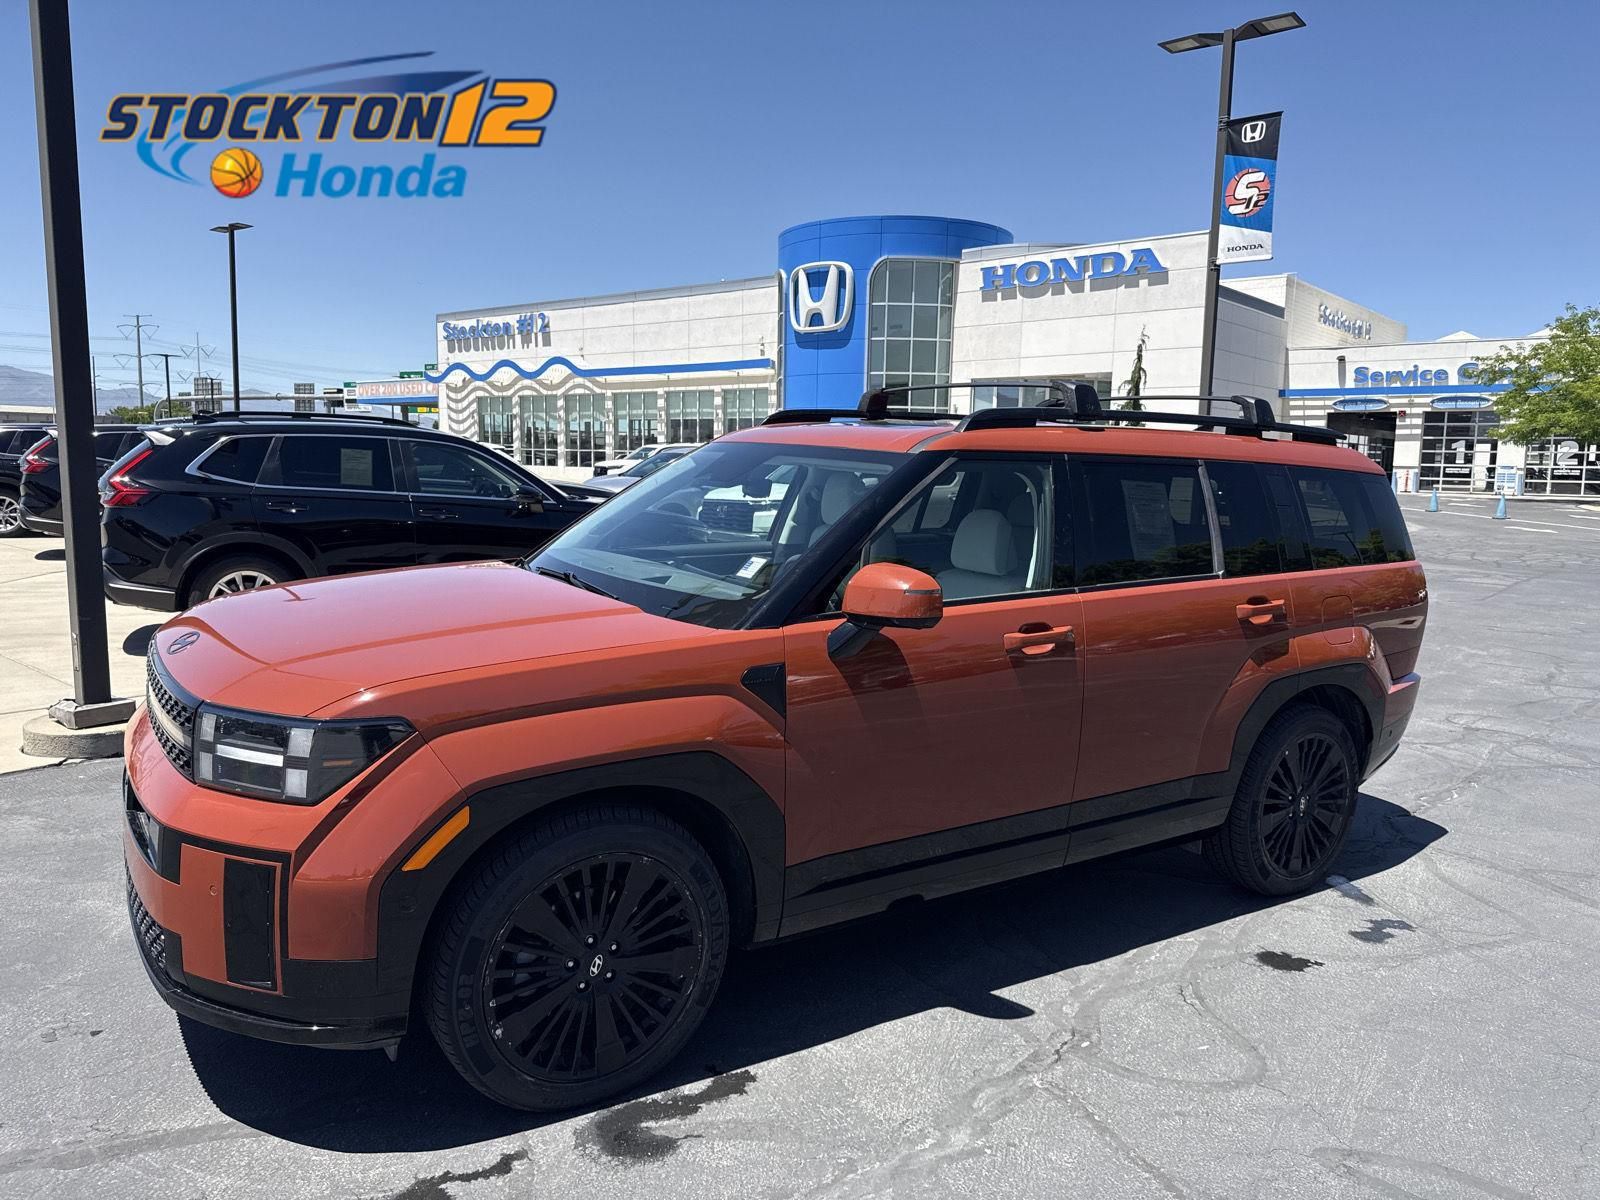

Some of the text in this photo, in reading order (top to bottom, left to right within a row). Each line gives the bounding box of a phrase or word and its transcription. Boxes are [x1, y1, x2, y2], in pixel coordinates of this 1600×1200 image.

[1227, 243, 1264, 252] HONDA
[980, 248, 1168, 291] HONDA
[443, 319, 514, 340] Stockton
[1354, 364, 1449, 384] Service
[359, 384, 380, 395] OVER
[382, 384, 398, 395] 200
[400, 383, 423, 394] USED
[1557, 440, 1579, 465] 2
